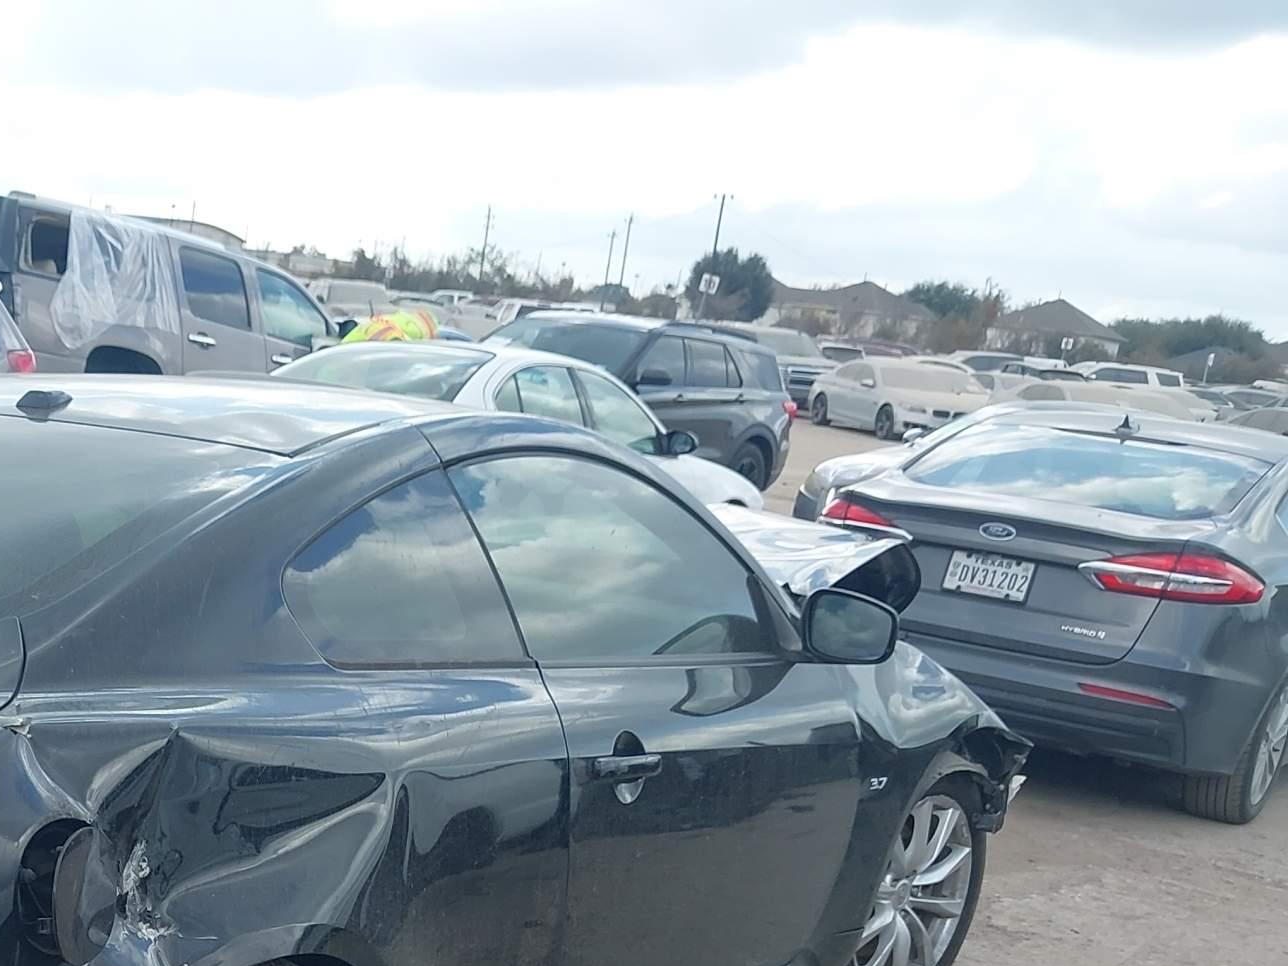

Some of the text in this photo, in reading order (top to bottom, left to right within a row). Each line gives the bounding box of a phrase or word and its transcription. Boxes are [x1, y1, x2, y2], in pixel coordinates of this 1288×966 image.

[974, 557, 1013, 569] TEXAS
[958, 564, 1029, 593] DV31202
[1060, 623, 1097, 638] HYBRID
